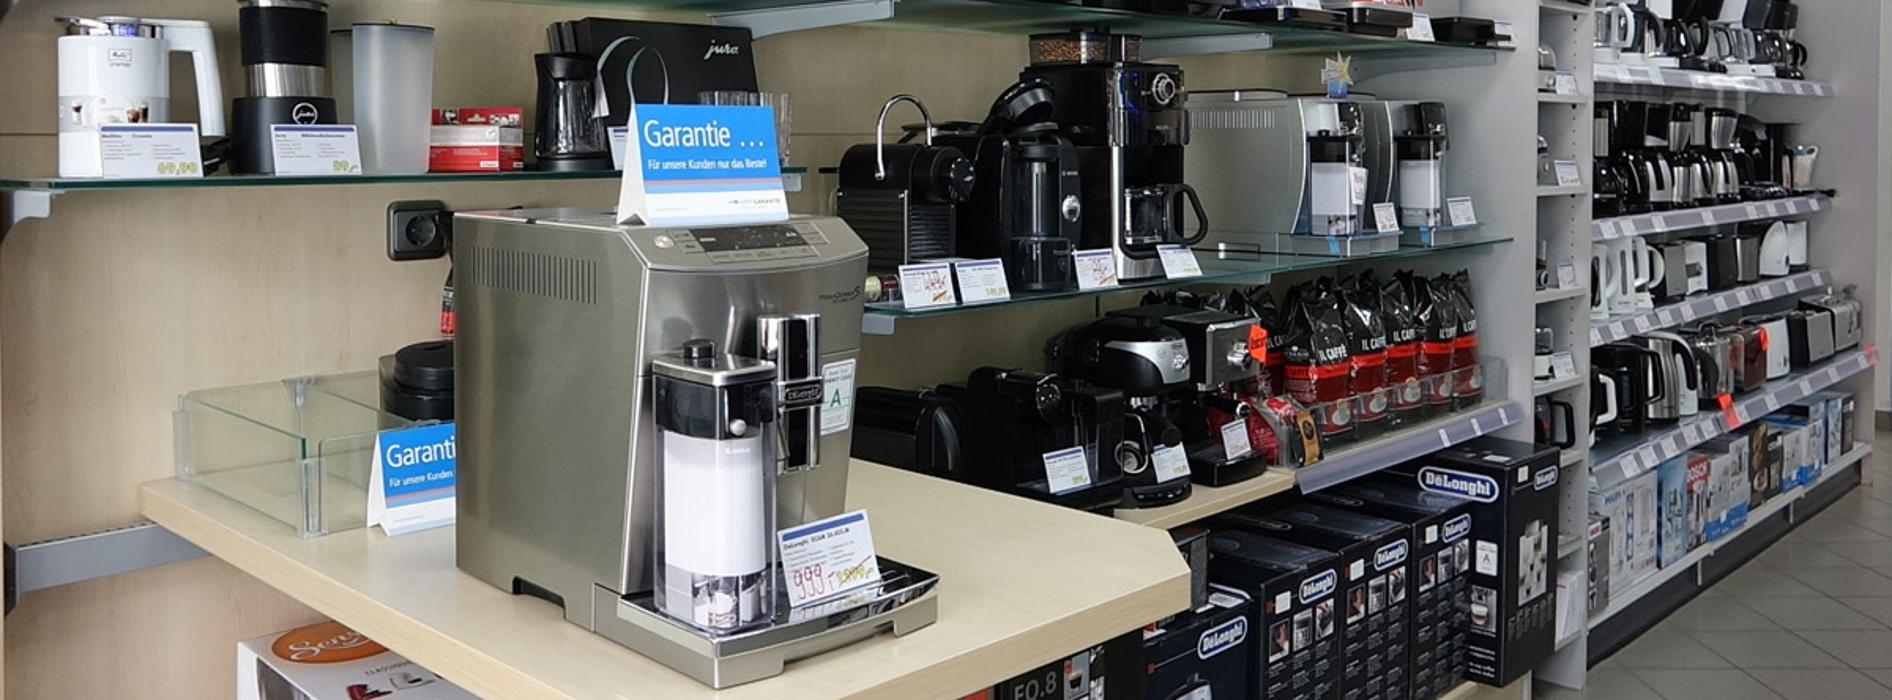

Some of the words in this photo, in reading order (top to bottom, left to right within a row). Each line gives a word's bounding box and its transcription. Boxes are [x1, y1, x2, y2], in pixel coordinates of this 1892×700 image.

[704, 39, 740, 60] jura
[643, 119, 731, 148] Garantie
[647, 158, 661, 170] Für
[662, 160, 687, 170] unsere
[688, 158, 717, 170] Kunden
[717, 159, 730, 169] nur
[731, 157, 745, 169] das
[1361, 339, 1369, 351] IL
[1394, 330, 1401, 342] IL
[830, 388, 841, 408] A
[386, 435, 456, 468] Garanti
[388, 476, 401, 489] Für
[402, 474, 426, 486] unsere
[427, 469, 454, 482] Kunden
